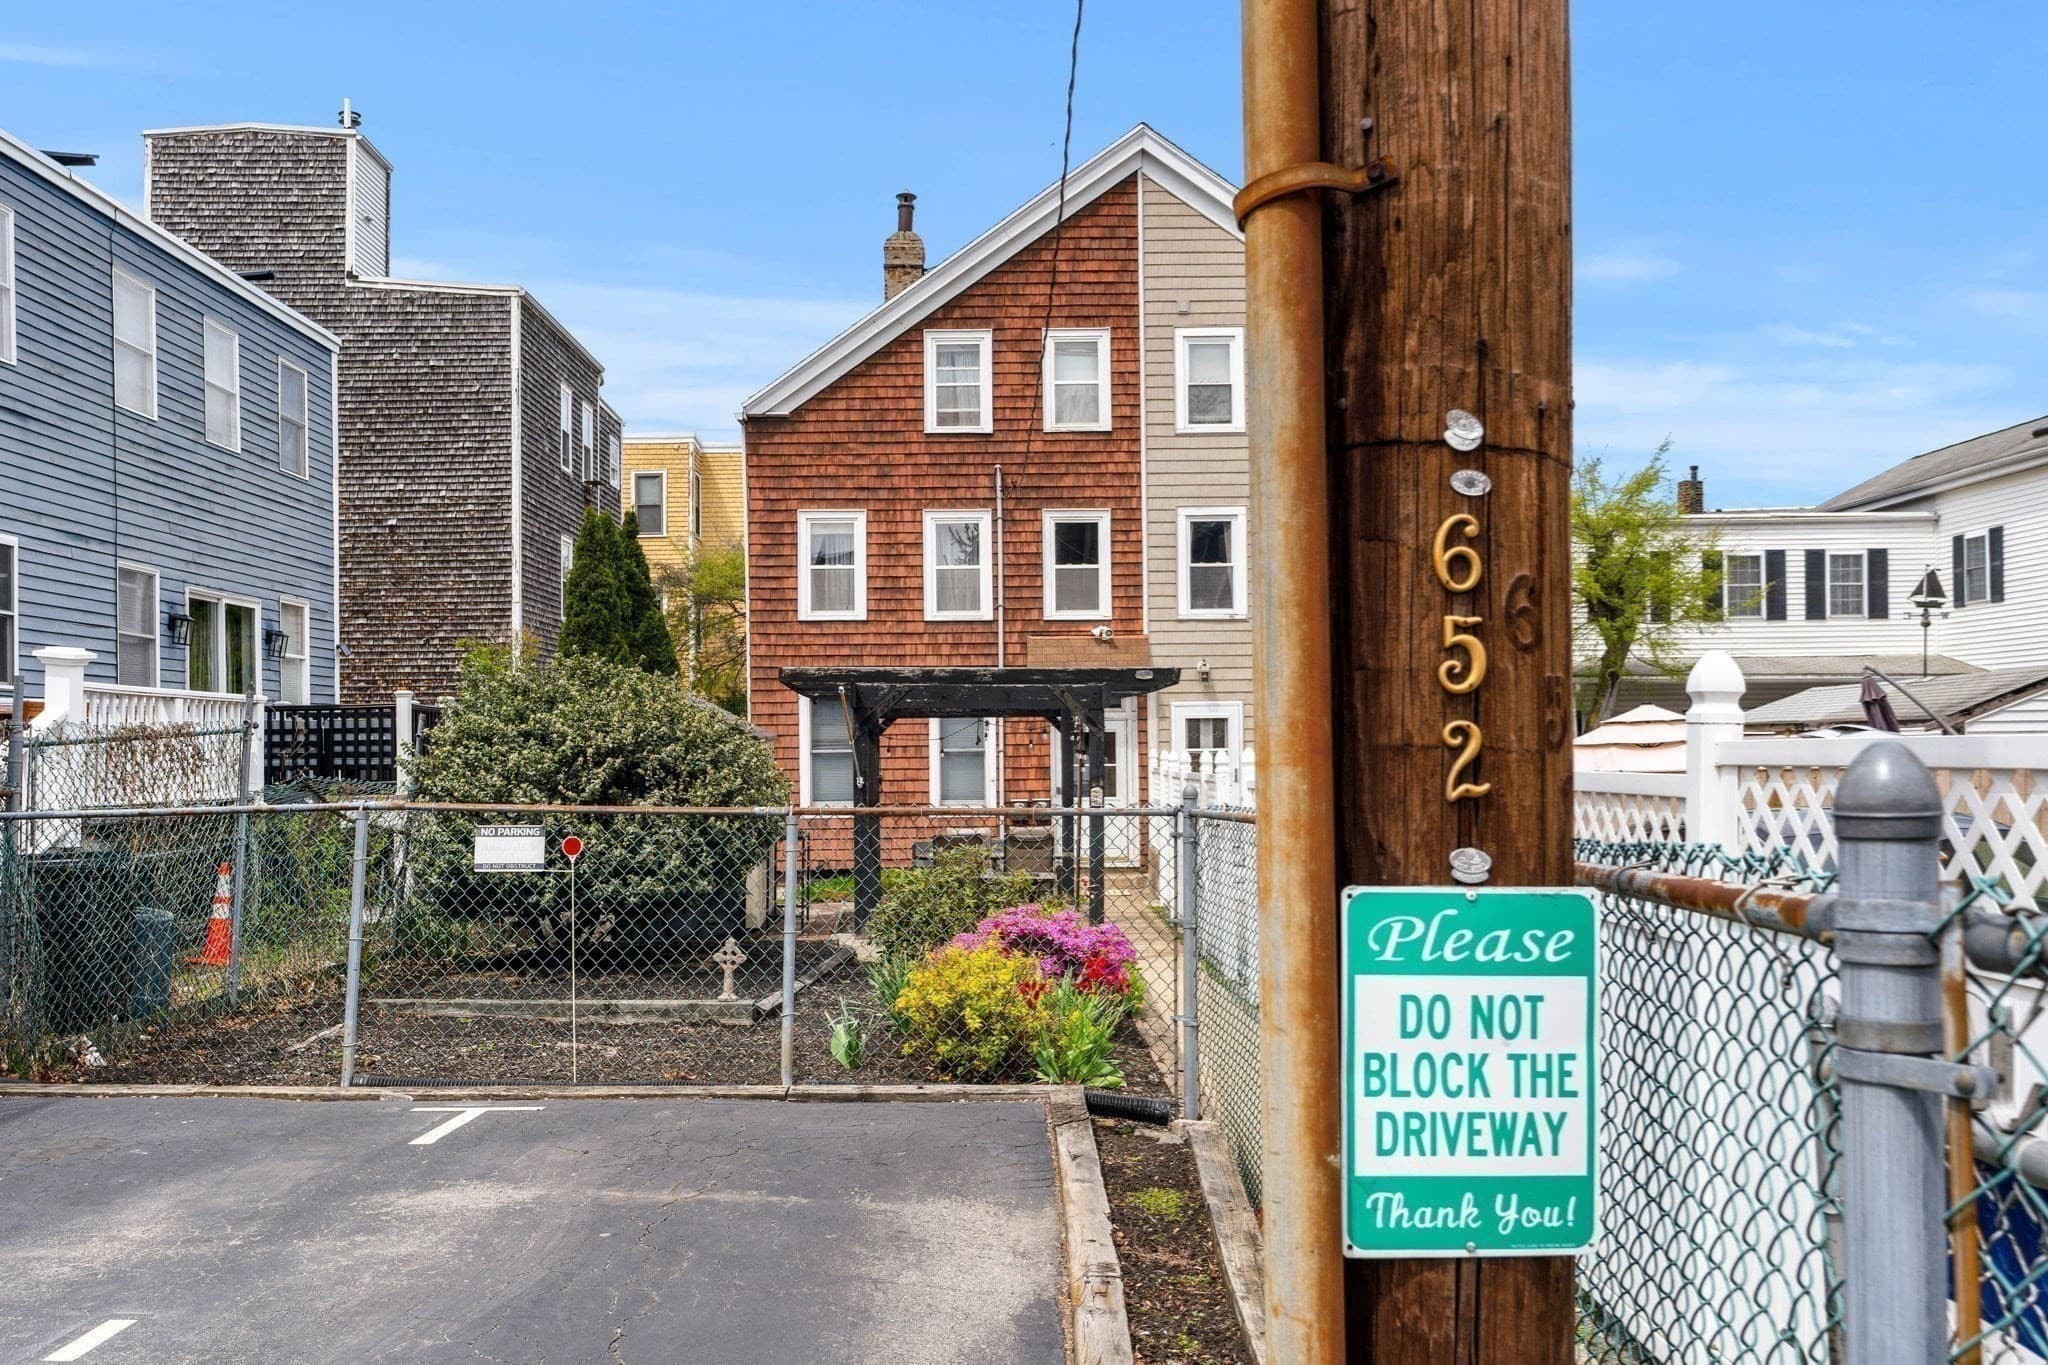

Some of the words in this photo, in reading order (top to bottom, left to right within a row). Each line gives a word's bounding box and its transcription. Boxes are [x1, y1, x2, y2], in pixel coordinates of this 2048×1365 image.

[1433, 513, 1492, 802] 652
[480, 827, 496, 836] NO
[497, 827, 540, 836] PARKING
[1367, 908, 1575, 963] Please
[1399, 994, 1451, 1040] DO
[1470, 994, 1545, 1040] NOT
[1363, 1052, 1491, 1099] BLOCK
[1507, 1053, 1579, 1099] THE
[1375, 1111, 1568, 1157] DRIVEWAY
[1365, 1191, 1482, 1229] Thank
[1494, 1193, 1577, 1235] You!
